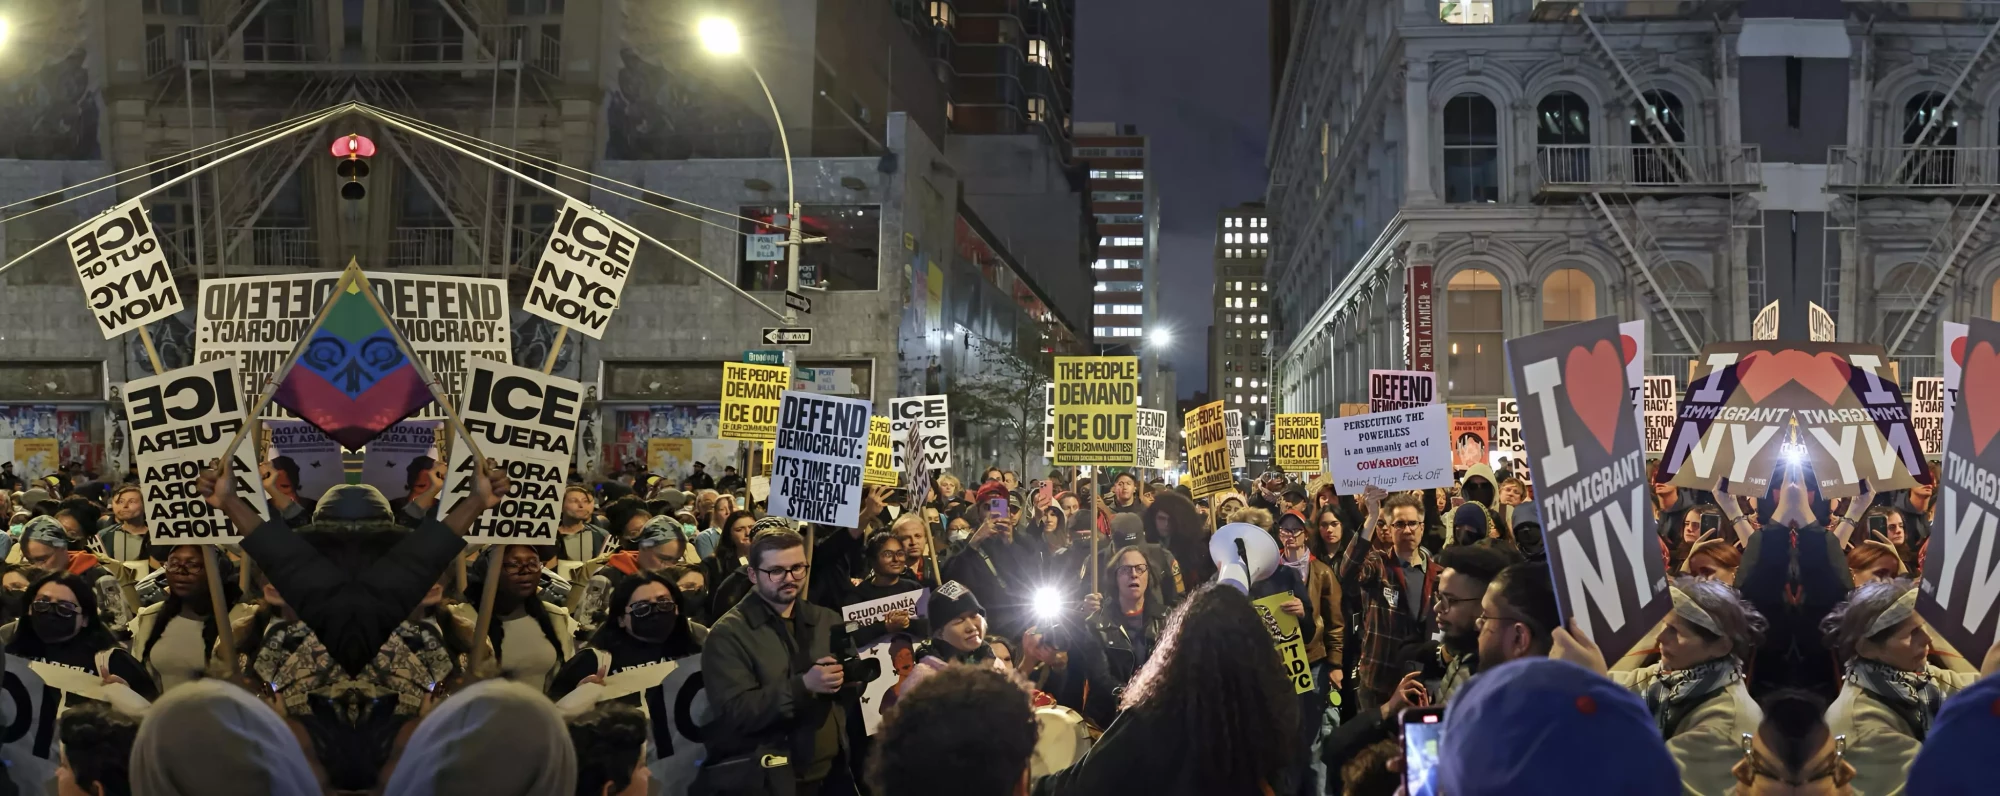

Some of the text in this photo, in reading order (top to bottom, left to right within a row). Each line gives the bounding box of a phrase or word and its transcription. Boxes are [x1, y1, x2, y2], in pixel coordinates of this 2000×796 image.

[557, 207, 635, 268] ICE
[551, 238, 626, 280] OUT OF
[538, 260, 617, 309] NYC
[367, 278, 503, 321] DEFEND
[529, 286, 608, 330] NOW
[1418, 294, 1432, 327] MANGER
[395, 319, 505, 343] MOCRACY:
[1418, 338, 1432, 358] PRET
[727, 367, 787, 384] THE PEOPLE
[1059, 362, 1134, 380] THE PEOPLE
[1692, 353, 1739, 403] I
[726, 381, 785, 400] DEMAND
[1060, 383, 1134, 405] DEMAND
[1372, 374, 1433, 402] DEFEND
[1644, 379, 1672, 399] END
[469, 368, 579, 430] ICE
[1371, 399, 1428, 413] DEMOCR
[1500, 401, 1519, 415] IC
[1644, 399, 1673, 411] RACY:
[724, 403, 780, 424] ICE OUT
[782, 396, 867, 438] DEFEND
[892, 400, 946, 420] ICE
[1137, 411, 1164, 428] FEND
[1187, 414, 1196, 430] THE
[1196, 405, 1222, 425] PEOPLE
[1680, 405, 1789, 423] IMMIGRANT
[875, 421, 890, 433] PEO
[925, 419, 946, 428] OF
[1059, 414, 1133, 440] ICE OUT
[1278, 417, 1319, 426] THE PEOPLE
[1344, 412, 1424, 430] PERSECUTING THE
[1523, 357, 1579, 488] I
[1655, 415, 1674, 428] FOR
[463, 418, 570, 455] FUERA
[1137, 426, 1164, 438] OCRACY:
[1187, 422, 1223, 450] DEMAND
[1278, 428, 1319, 439] DEMAND
[1359, 427, 1410, 441] POWERLESS
[1645, 427, 1669, 440] ERAL
[778, 428, 862, 459] DEMOCRACY:
[1058, 442, 1133, 452] OF OUR COMMUNITIES!
[1137, 447, 1159, 458] ENERAL
[1278, 444, 1319, 458] ICE OUT
[1344, 447, 1351, 456] is
[1366, 441, 1402, 453] unmanly
[1404, 440, 1417, 449] act
[1420, 437, 1430, 447] of
[1645, 439, 1662, 452] IKE!
[1666, 421, 1781, 483] NY
[455, 455, 563, 483] AORA
[876, 452, 891, 469] OU
[893, 452, 948, 467] NW
[1137, 457, 1155, 467] TRIKE!
[1190, 454, 1203, 478] ICE
[1204, 448, 1226, 473] OUT
[1356, 456, 1419, 471] COWARDICE!
[775, 456, 800, 478] IT'S
[801, 459, 832, 483] TIME
[833, 463, 861, 487] FOR
[1402, 471, 1423, 481] Fuck
[1425, 468, 1444, 480] Off
[780, 477, 848, 505] A GENERAL
[1544, 450, 1642, 532] IMMIGRANT
[787, 497, 838, 523] STRIKE!
[1557, 484, 1653, 647] NY
[848, 596, 916, 621] CIUDADANÍA
[858, 616, 880, 626] ARA
